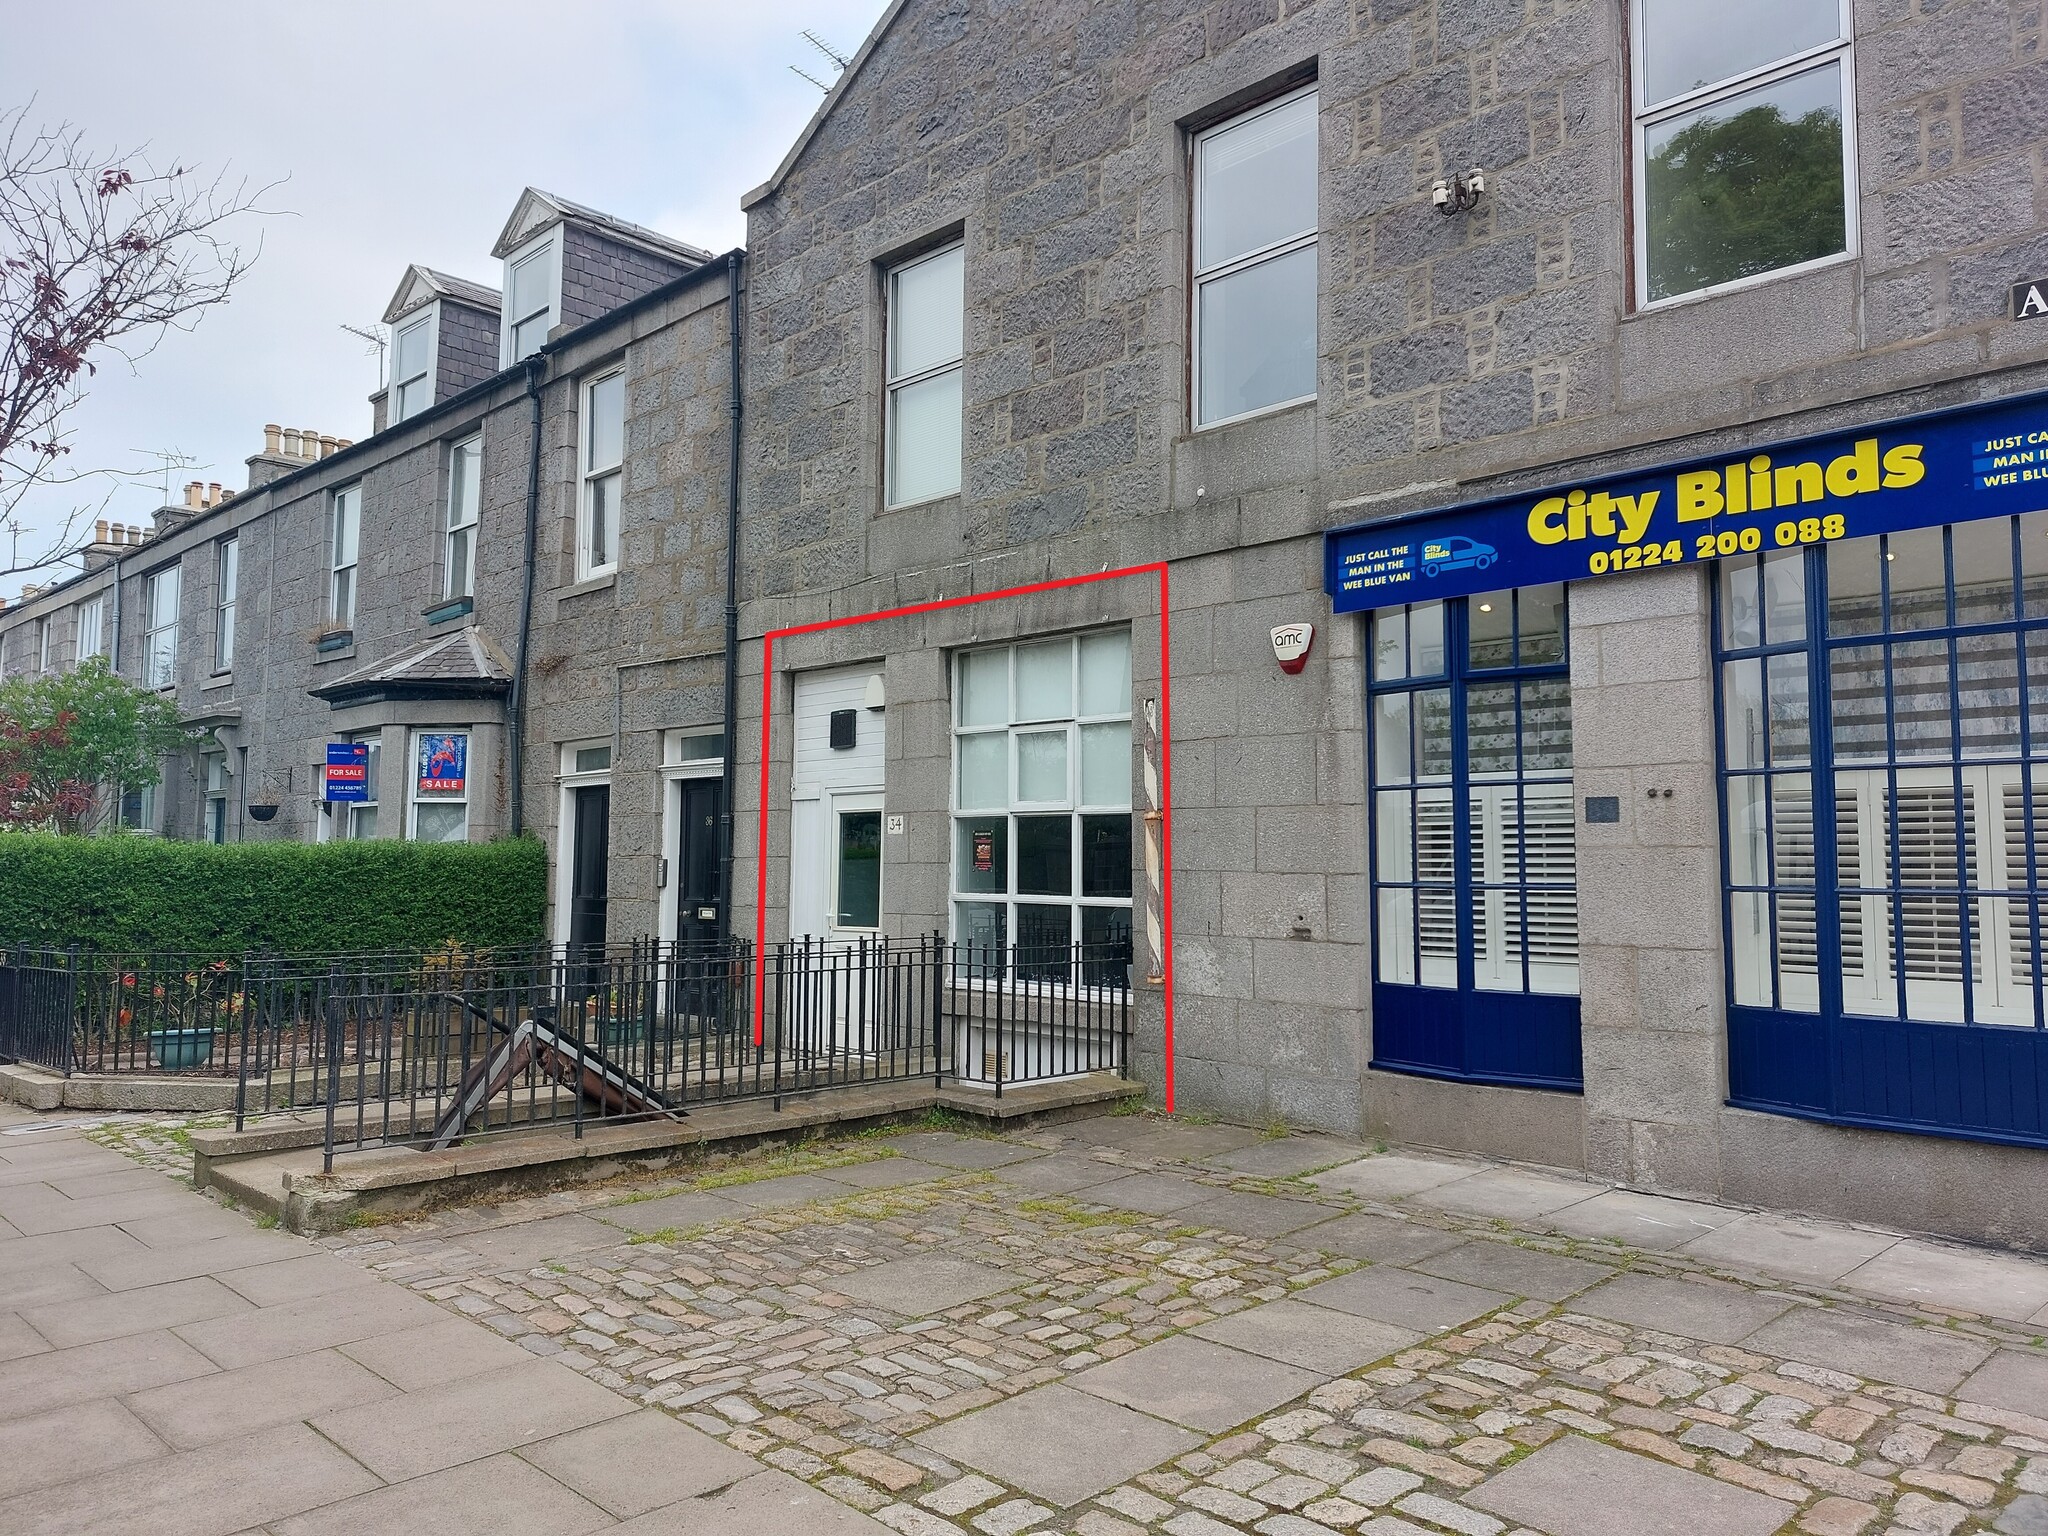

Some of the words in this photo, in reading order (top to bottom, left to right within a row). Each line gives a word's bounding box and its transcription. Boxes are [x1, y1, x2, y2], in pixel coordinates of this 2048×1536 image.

[1984, 435, 2023, 452] JUST
[2027, 431, 2048, 444] CA
[1993, 451, 2034, 468] MAN
[1983, 472, 2018, 487] WEE
[1526, 488, 1660, 545] City
[1676, 437, 1926, 523] Blinds
[1424, 544, 1442, 553] City
[1589, 540, 1683, 574] 01224
[1695, 527, 1761, 559] 200
[1774, 514, 1845, 547] 088
[1344, 553, 1366, 565] JUST
[1367, 549, 1390, 561] CALL
[1391, 545, 1409, 556] THE
[1424, 550, 1450, 560] Blinds
[1348, 565, 1372, 577] MAN
[1373, 562, 1385, 572] IN
[1387, 560, 1404, 570] THE
[1343, 578, 1363, 590] WEE
[1364, 576, 1387, 587] BLUE
[1389, 572, 1411, 584] VAN
[1274, 632, 1303, 647] amc
[426, 780, 458, 788] SALE
[889, 817, 902, 831] 34
